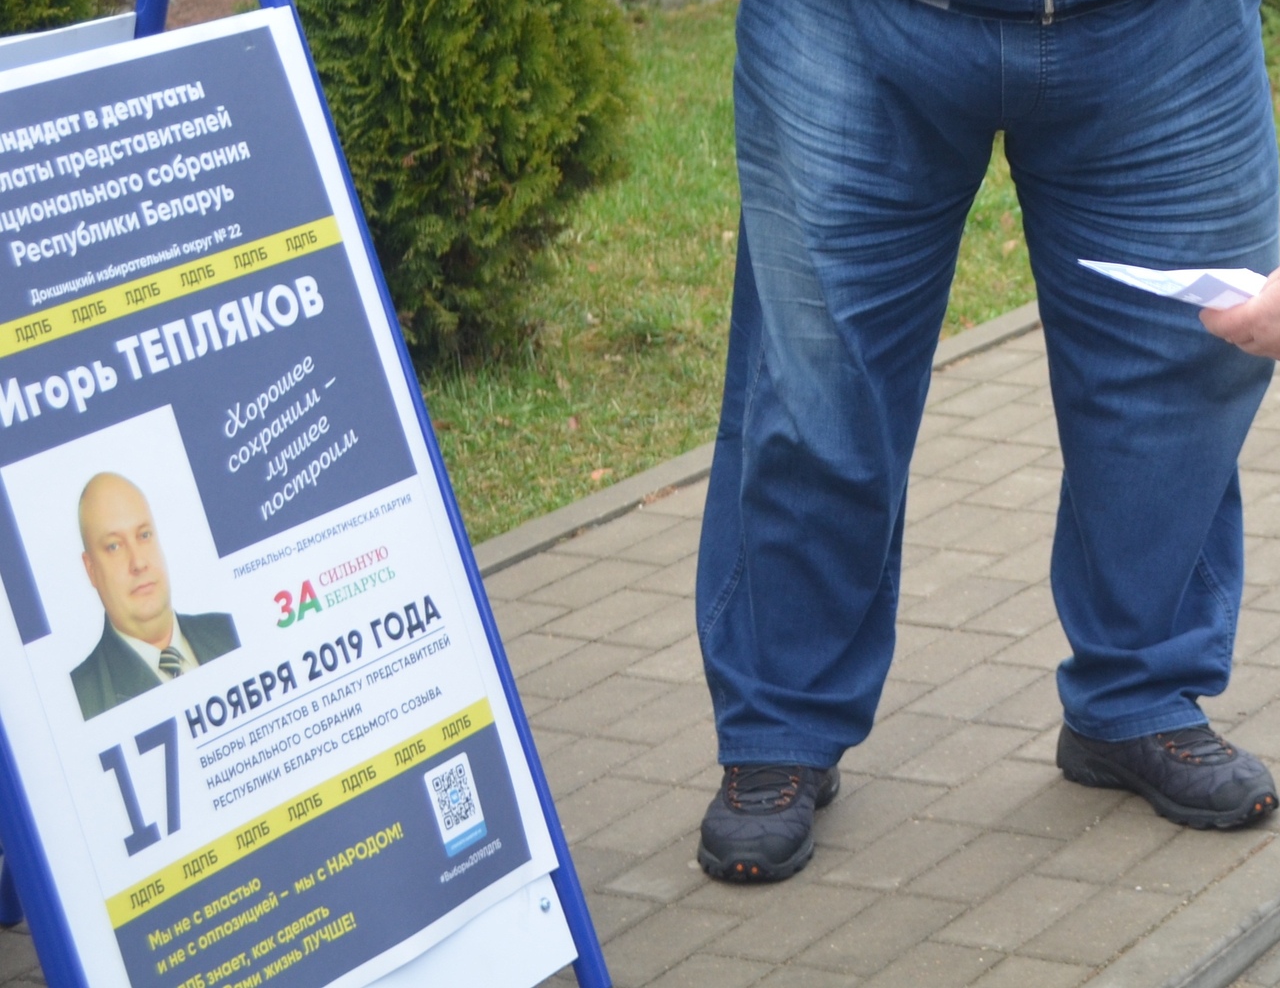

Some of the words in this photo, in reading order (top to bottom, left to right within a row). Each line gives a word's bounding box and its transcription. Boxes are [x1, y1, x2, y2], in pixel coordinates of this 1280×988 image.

[0, 113, 80, 153] ндидат
[84, 110, 99, 129] в
[101, 81, 205, 130] депутаты
[56, 105, 233, 178] представителей
[0, 173, 143, 233] ционального
[147, 141, 251, 187] собрания
[11, 211, 141, 267] Республики
[140, 184, 235, 227] Беларуь
[15, 319, 52, 343] ЛДПБ
[72, 300, 107, 324] ЛДПБ
[125, 282, 161, 305] ЛДПБ
[180, 264, 216, 287] ЛДПБ
[234, 247, 268, 269] ЛДПБ
[285, 230, 318, 252] ЛДПБ
[30, 272, 96, 306] Докшицкий
[96, 243, 181, 283] избирательный
[183, 234, 213, 254] округ
[214, 228, 228, 244] №
[228, 223, 243, 239] 22
[0, 360, 118, 428] Игорь
[115, 275, 325, 381] ТЕПЛЯКОВ
[224, 355, 315, 438] Хорошее
[228, 388, 321, 473] сохраним
[260, 428, 359, 521] построим
[266, 415, 331, 482] лучшее
[233, 507, 381, 580] ЛИБЕРАЛЬНО-ДЕМОКРАТИЧЕСКАЯ
[380, 493, 413, 516] ПАРТИЯ
[273, 579, 323, 629] ЗА
[318, 545, 390, 588] СИЛЬНУЮ
[324, 565, 397, 609] БЕЛАРУСЬ
[185, 660, 298, 739] НОЯБРЯ
[301, 629, 363, 682] 2019
[369, 594, 443, 649] ГОДА
[199, 736, 247, 769] ВЫБОРЫ
[249, 705, 310, 746] ДЕПУТАТОВ
[311, 700, 320, 713] В
[322, 679, 364, 707] ПАЛАТУ
[365, 633, 452, 687] ПРЕДСТАВИТЕЛЕЙ
[98, 716, 181, 858] 17
[206, 733, 302, 790] НАЦИОНАЛЬНОГО
[303, 703, 363, 740] СОБРАНИЯ
[212, 767, 283, 811] РЕСПУБЛИКИ
[283, 739, 339, 775] БЕЛАРУСЬ
[341, 708, 399, 745] СЕДЬМОГО
[401, 686, 443, 714] СОЗЫВА
[130, 879, 166, 910] ЛДПБ
[182, 849, 219, 880] ЛДПБ
[235, 820, 271, 850] ЛДПБ
[287, 793, 323, 822] ЛДПБ
[341, 765, 377, 794] ЛДПБ
[393, 739, 427, 767] ЛДПБ
[441, 714, 472, 741] ЛДПБ
[148, 927, 173, 951] Мы
[173, 917, 191, 937] не
[193, 910, 204, 924] с
[203, 878, 262, 919] властью
[157, 958, 168, 975] и
[168, 948, 186, 968] не
[187, 942, 197, 955] с
[198, 891, 279, 949] оппозицией
[294, 873, 316, 894] мы
[317, 867, 327, 881] с
[326, 821, 404, 876] НАРОДОМ!
[206, 952, 251, 986] знает,
[251, 936, 277, 959] как
[277, 905, 330, 943] сделать
[263, 948, 303, 980] жизнь
[302, 911, 357, 955] ЛУЧШЕ!
